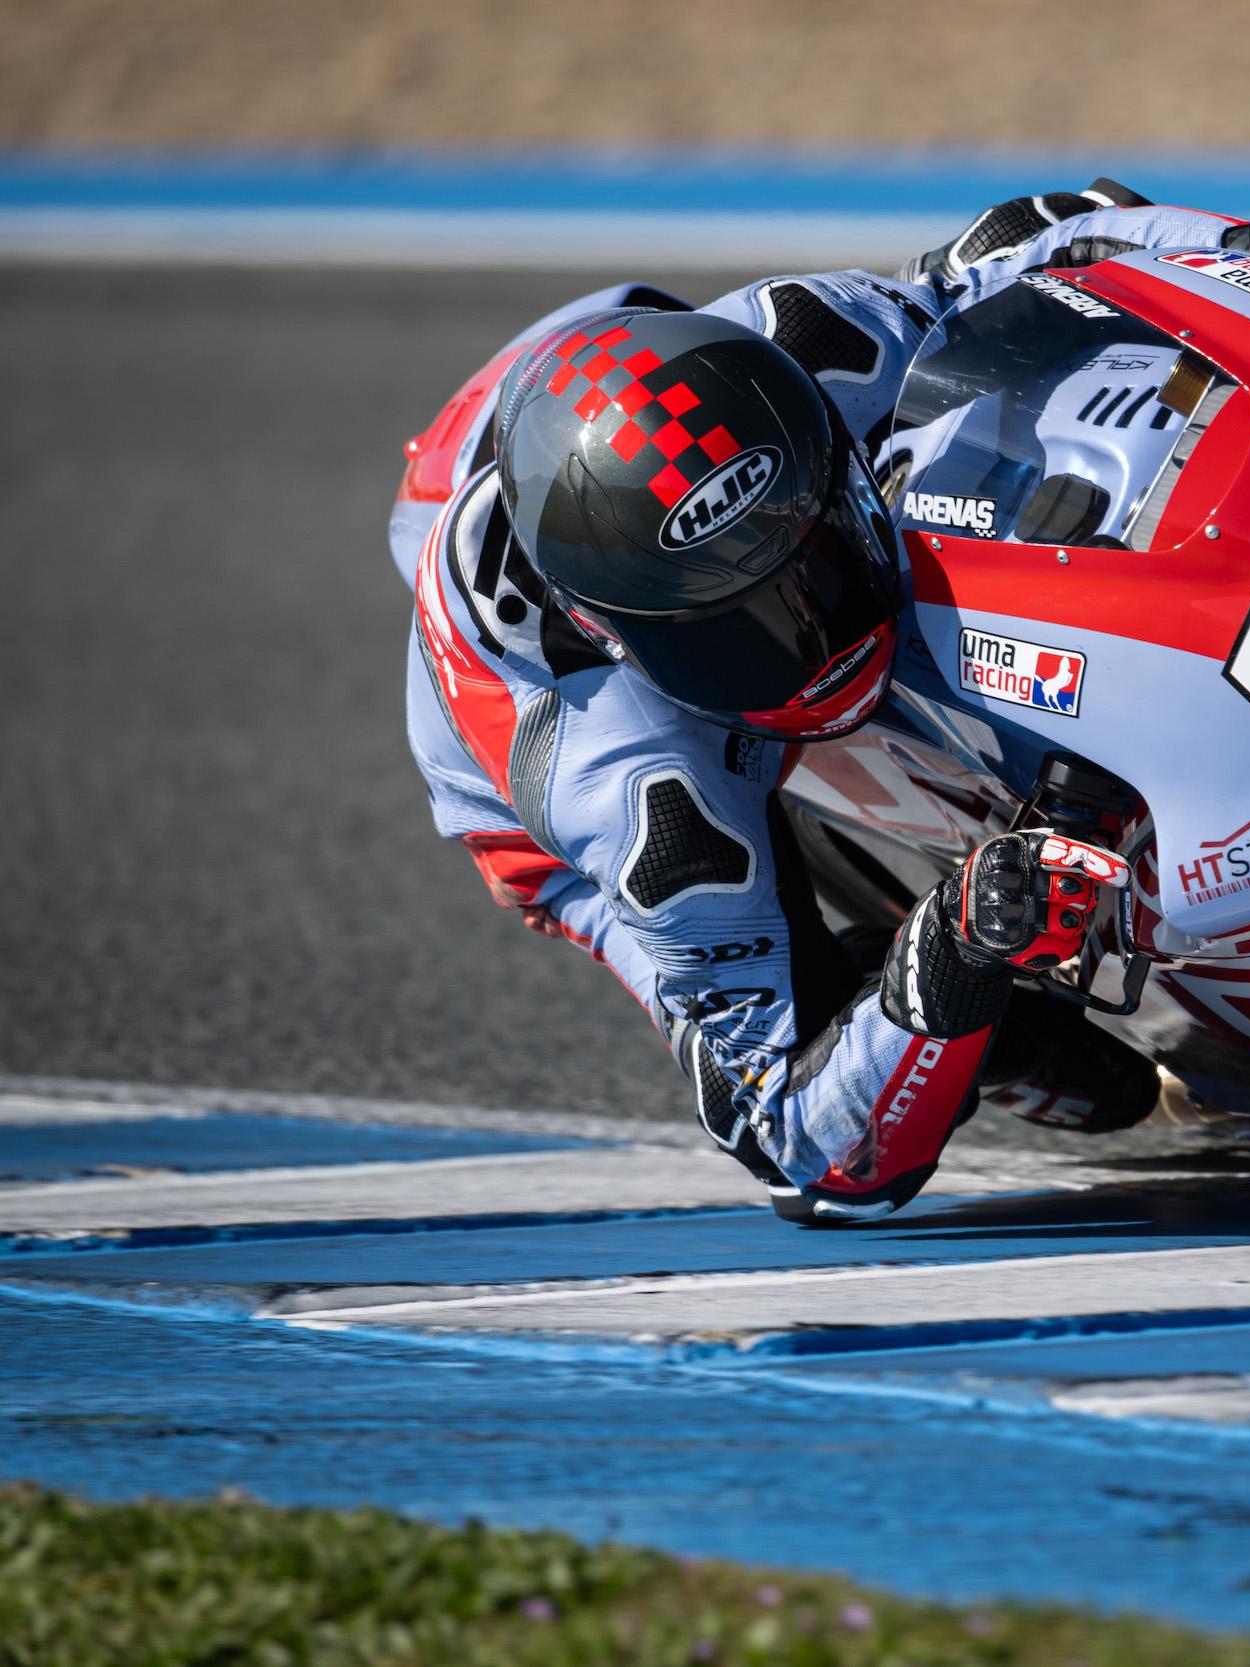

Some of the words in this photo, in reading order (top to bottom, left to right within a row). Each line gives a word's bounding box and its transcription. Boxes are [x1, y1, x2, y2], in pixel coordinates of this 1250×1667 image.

[677, 452, 768, 542] HJC
[902, 491, 996, 530] ARENAS
[962, 633, 1016, 669] uma
[963, 661, 1032, 701] racing
